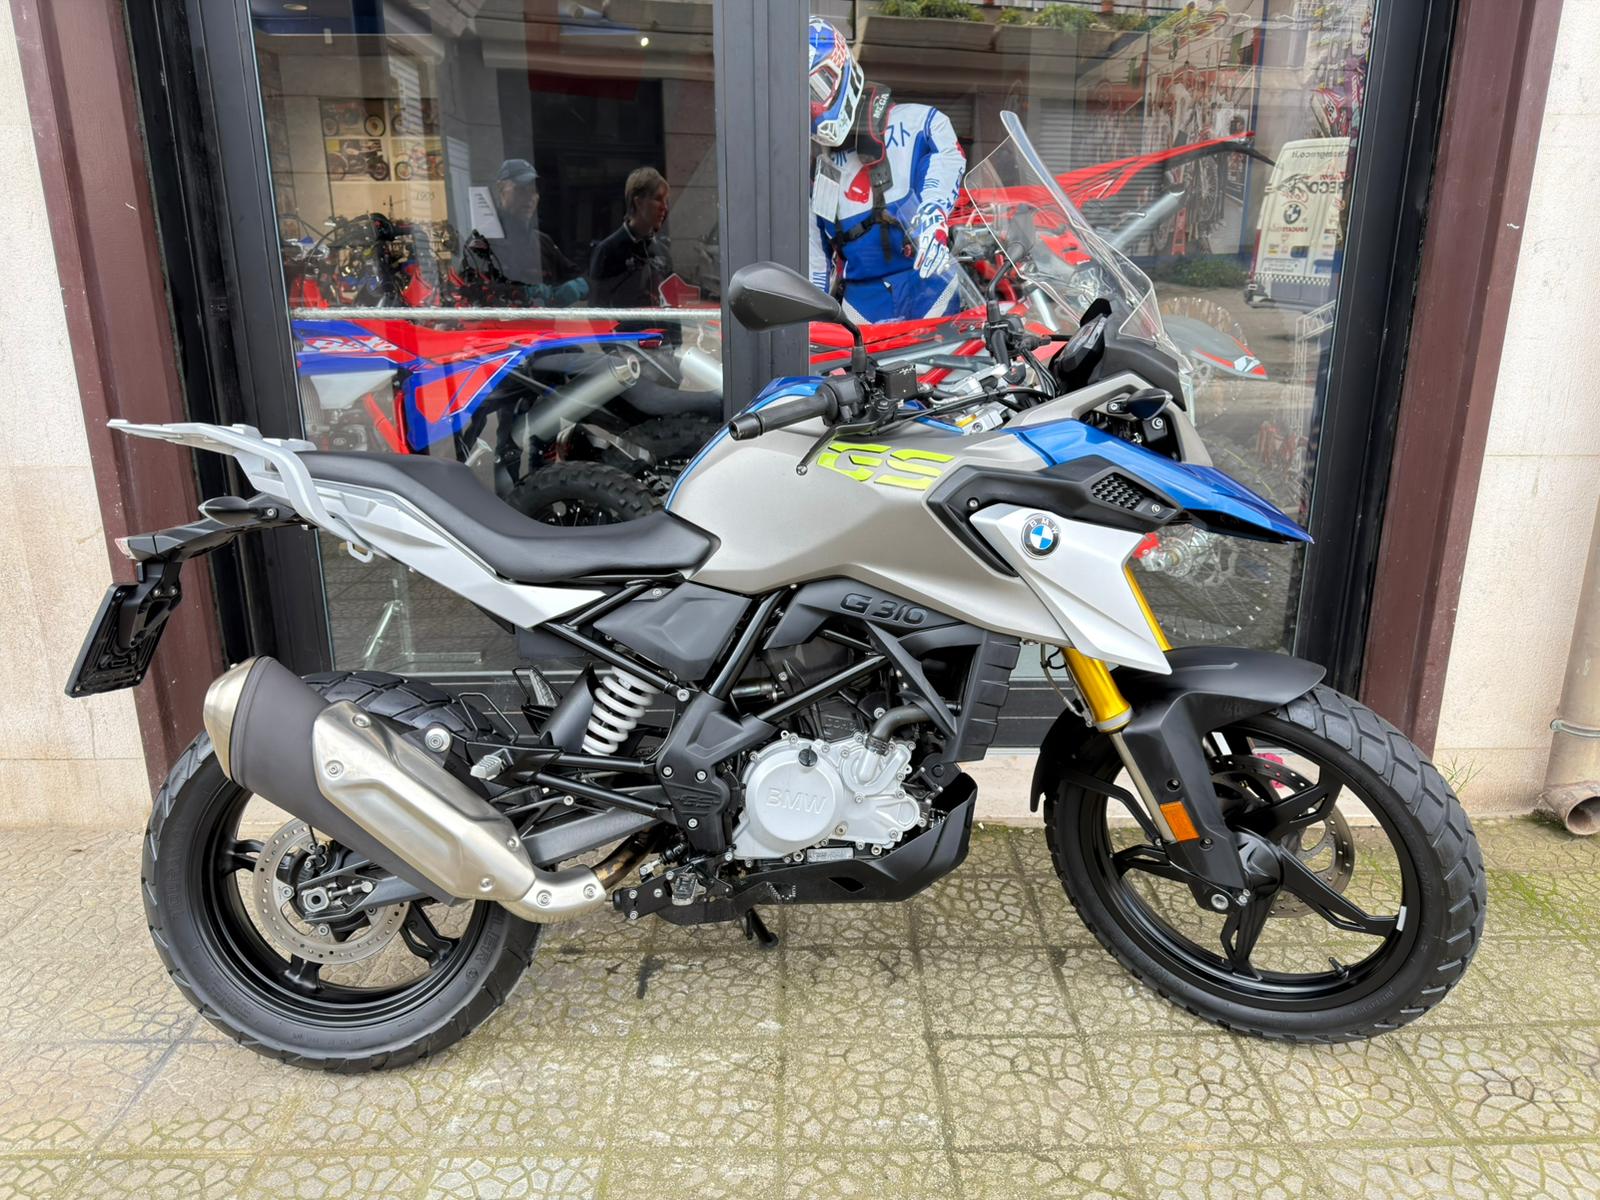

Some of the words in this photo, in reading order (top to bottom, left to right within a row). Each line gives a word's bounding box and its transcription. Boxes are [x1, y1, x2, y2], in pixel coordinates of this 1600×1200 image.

[816, 443, 956, 491] GS
[1028, 517, 1060, 535] BMW
[839, 592, 873, 616] G
[872, 600, 929, 625] 310
[765, 786, 827, 815] BMW
